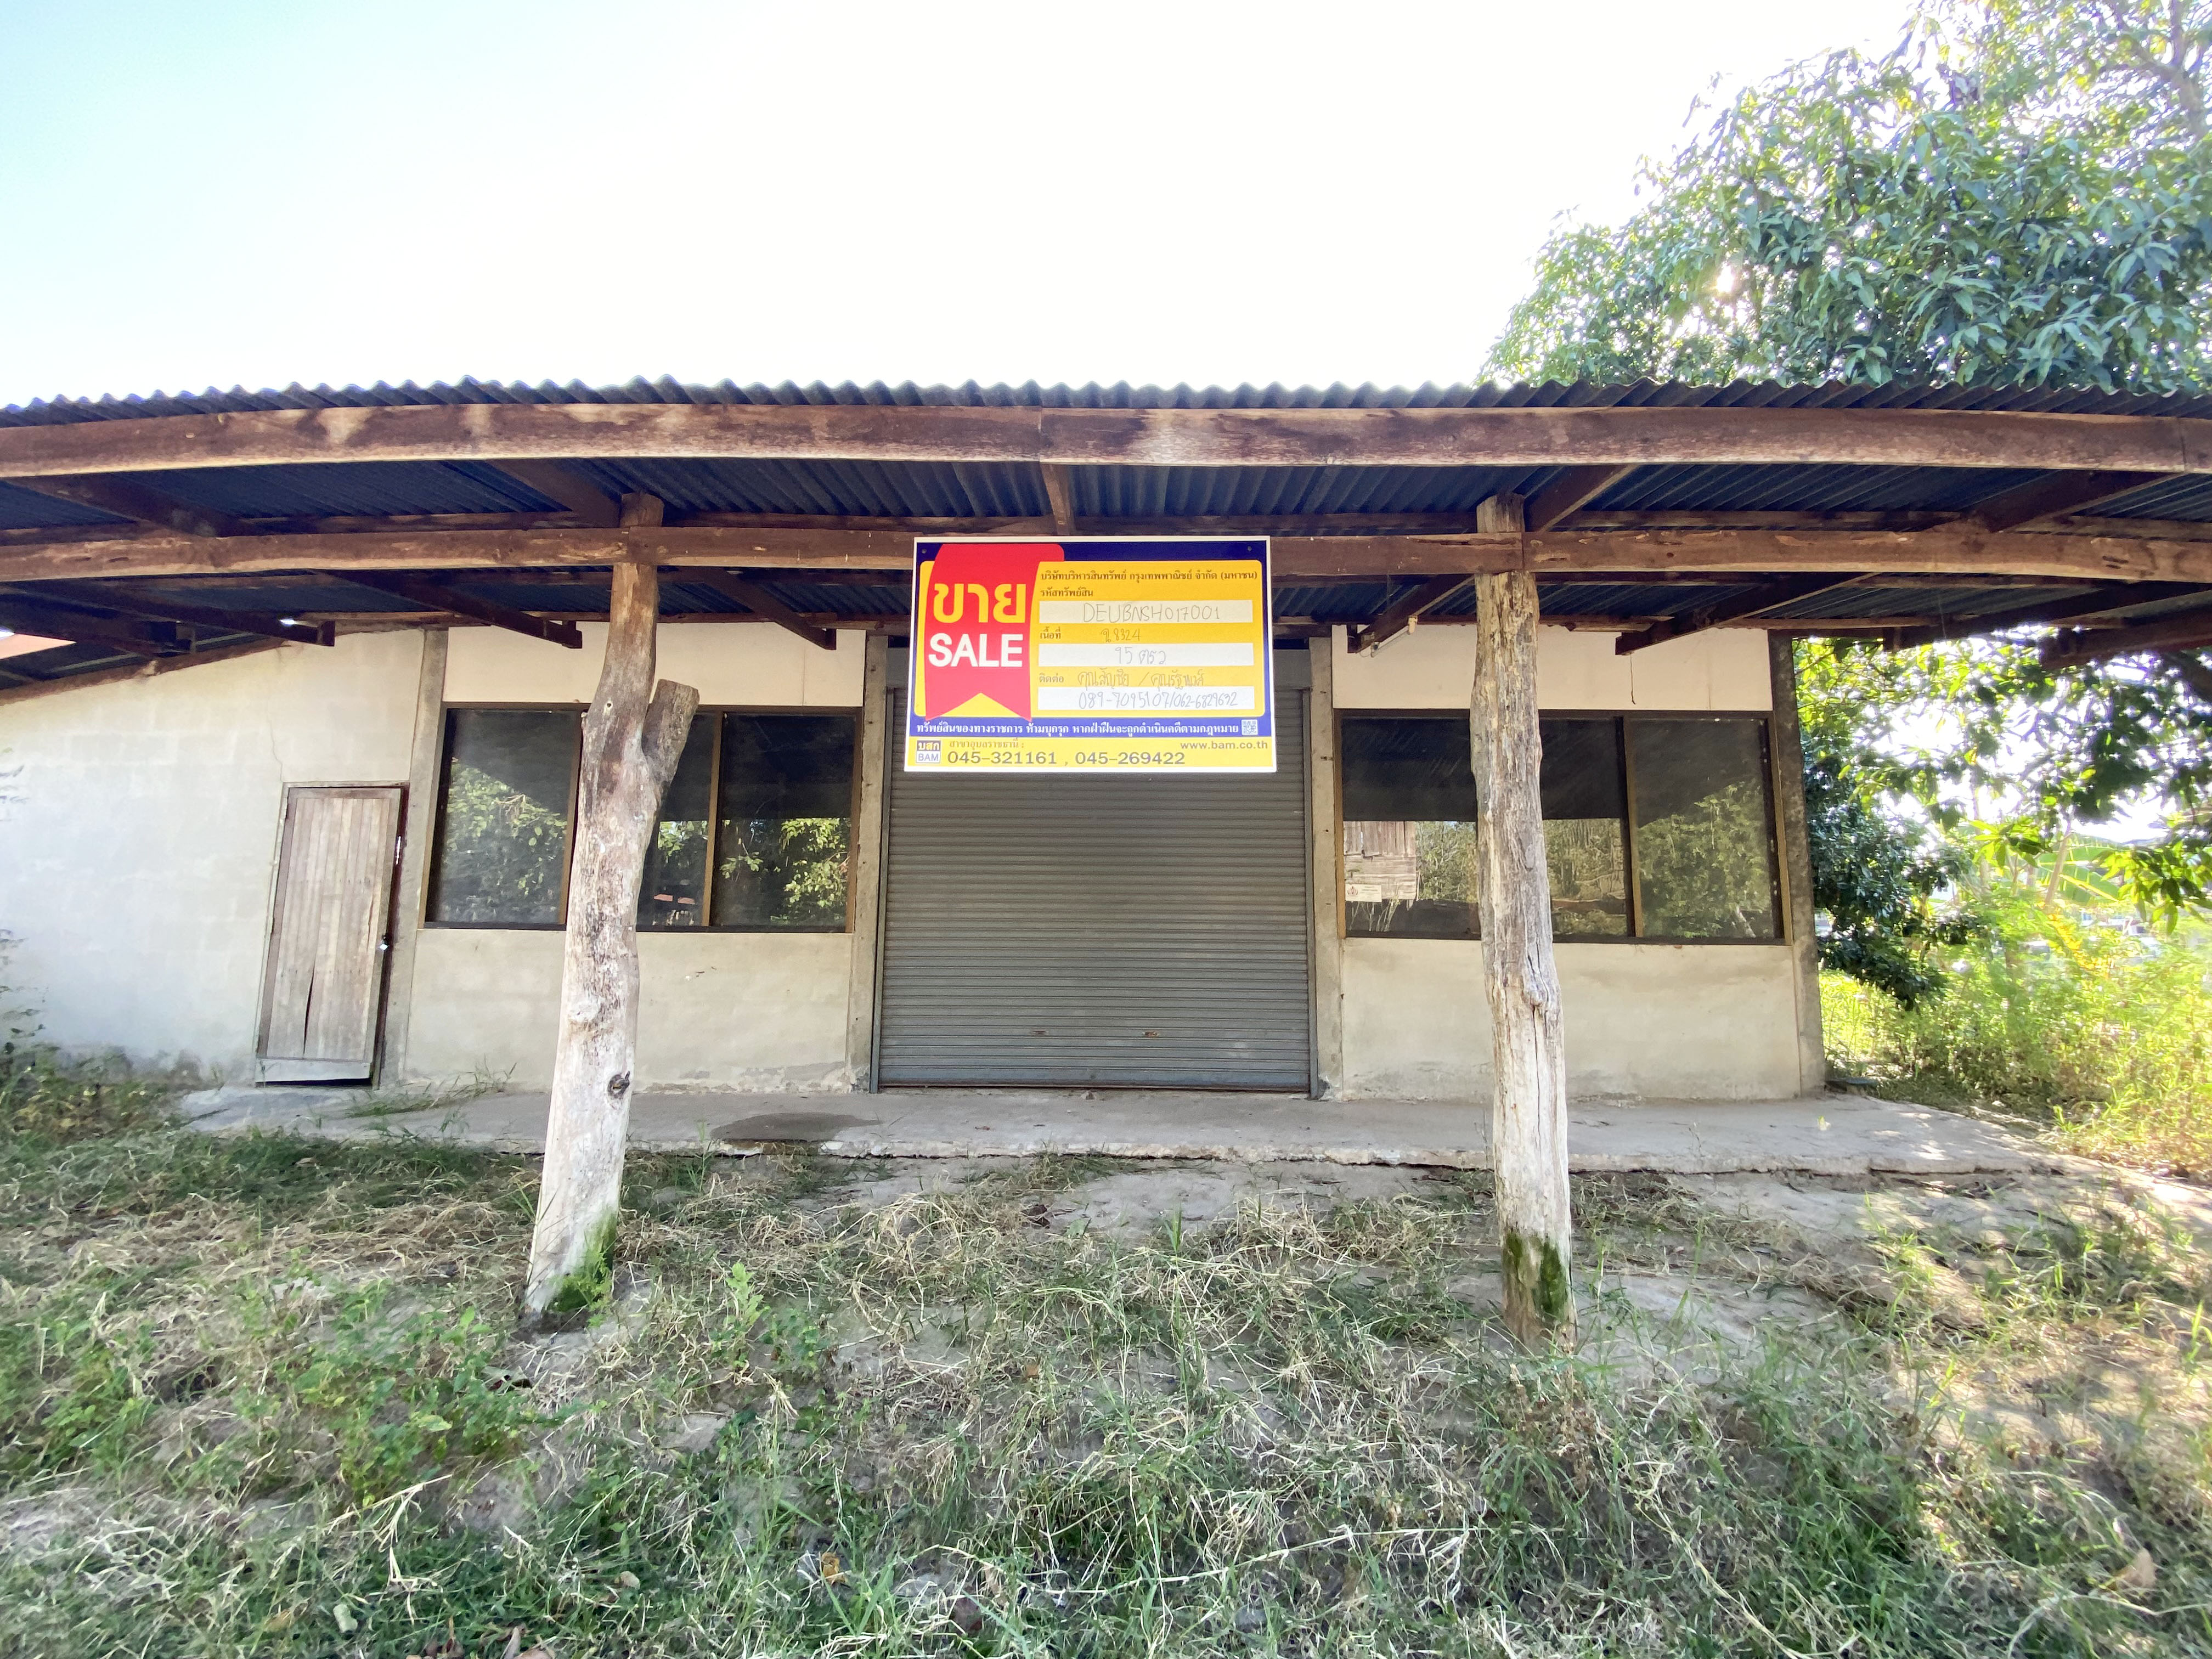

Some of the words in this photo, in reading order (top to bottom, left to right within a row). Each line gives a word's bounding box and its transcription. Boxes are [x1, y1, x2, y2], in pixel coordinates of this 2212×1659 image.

[1041, 570, 1126, 580] บริษัทบริหารสินทรัพย์
[1130, 571, 1192, 583] กรุงเทพพาณิชย์
[1195, 570, 1217, 580] จำกัด
[1221, 571, 1257, 580] (มหาชน)
[1040, 586, 1093, 597] รหัสทรัพย์สิน
[933, 583, 1026, 623] ขาย
[1040, 626, 1061, 640] เนื้อที่
[1113, 628, 1141, 641] 8324
[928, 633, 1023, 667] SALE
[1115, 646, 1133, 664] 95
[1039, 673, 1064, 684] ติดต่อ
[917, 721, 1022, 733] ทรัพย์สินของทางราชการ
[1026, 722, 1069, 736] ห้ามบุกรุก
[1073, 721, 1239, 736] หากฝ่าฝืนจะถูกดำเนินคดีตามกฎหมาย
[918, 741, 940, 751] บสก
[1180, 740, 1268, 749] www.bam.co.th
[918, 753, 939, 761] BAM
[947, 751, 1057, 764] 045-321161
[1075, 752, 1185, 765] 045-269422
